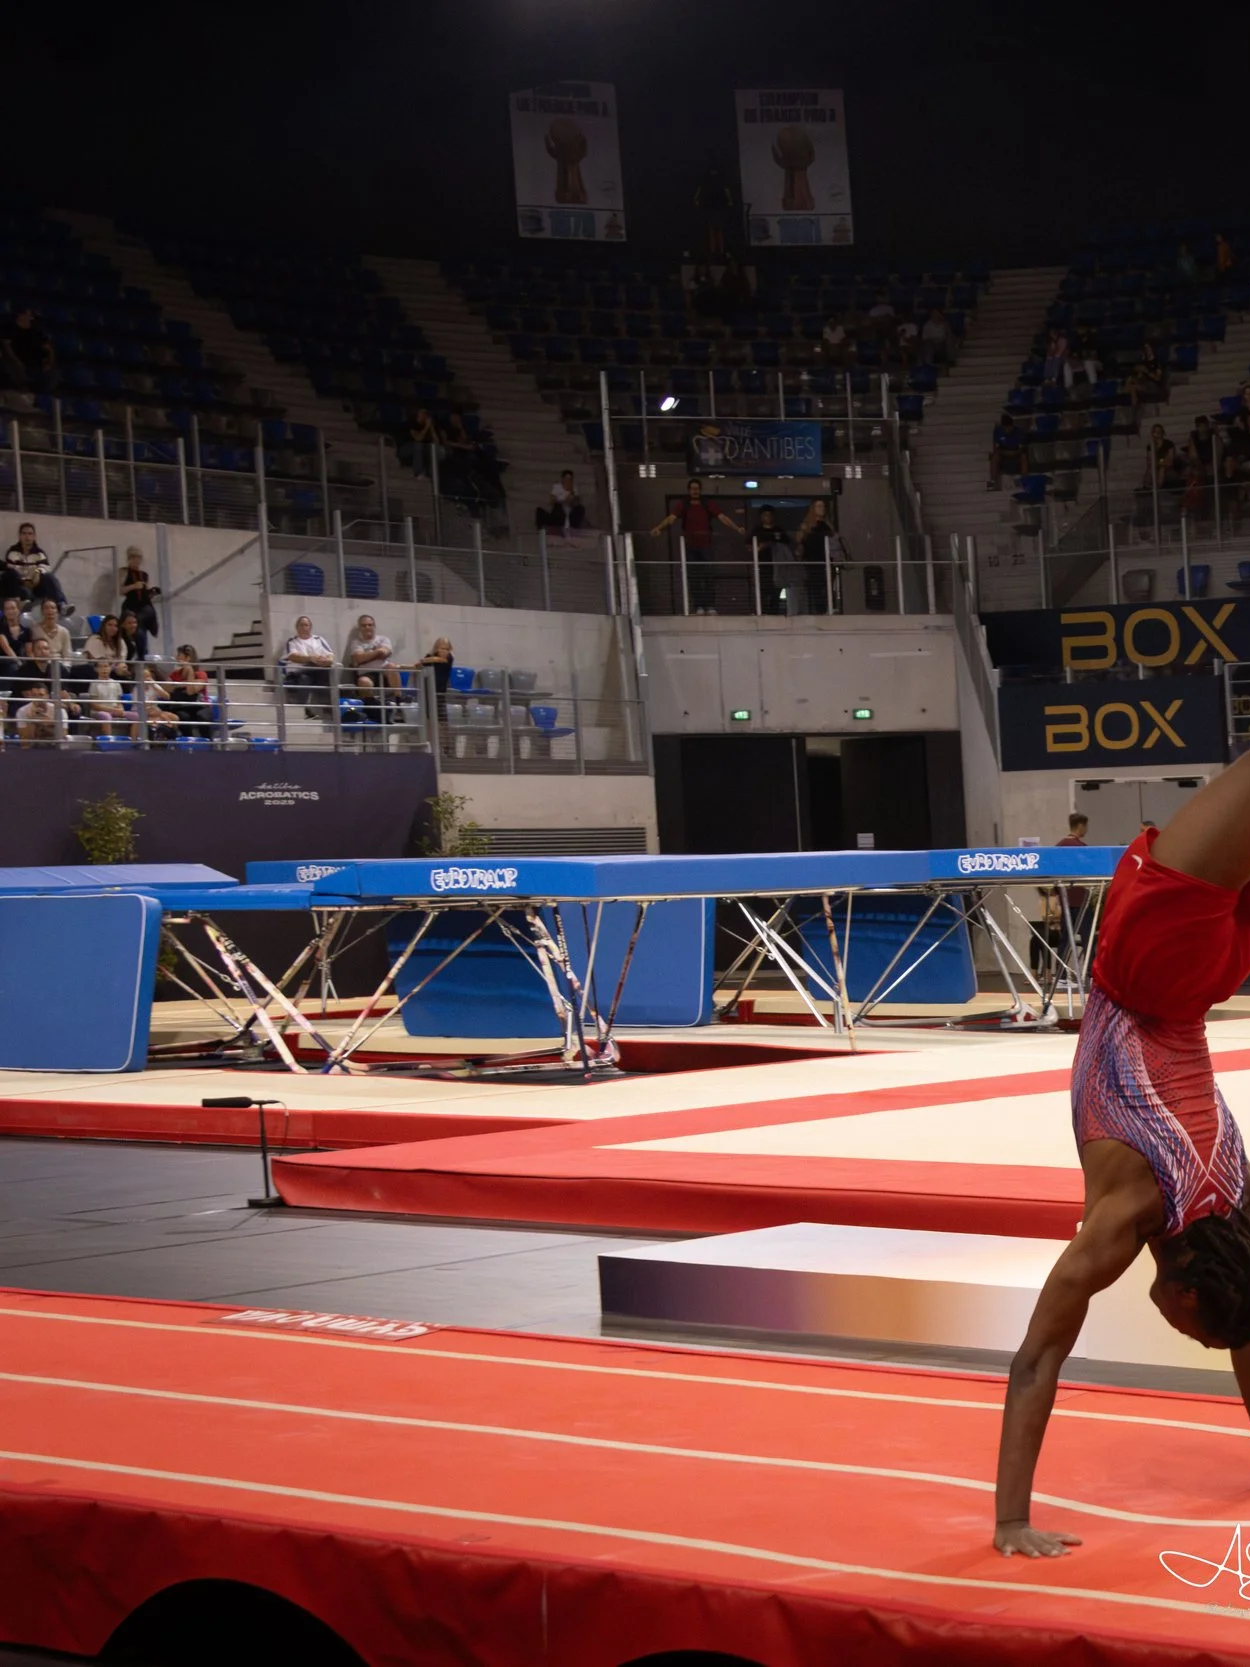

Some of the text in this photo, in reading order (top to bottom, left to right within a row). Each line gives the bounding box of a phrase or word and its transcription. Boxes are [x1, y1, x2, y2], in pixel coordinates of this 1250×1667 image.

[1060, 603, 1238, 670] BOX
[1044, 699, 1186, 753] BOX
[238, 791, 320, 801] ACROBATICS
[958, 853, 1040, 873] EUROTRAMP
[430, 867, 519, 891] EUROTRAMP
